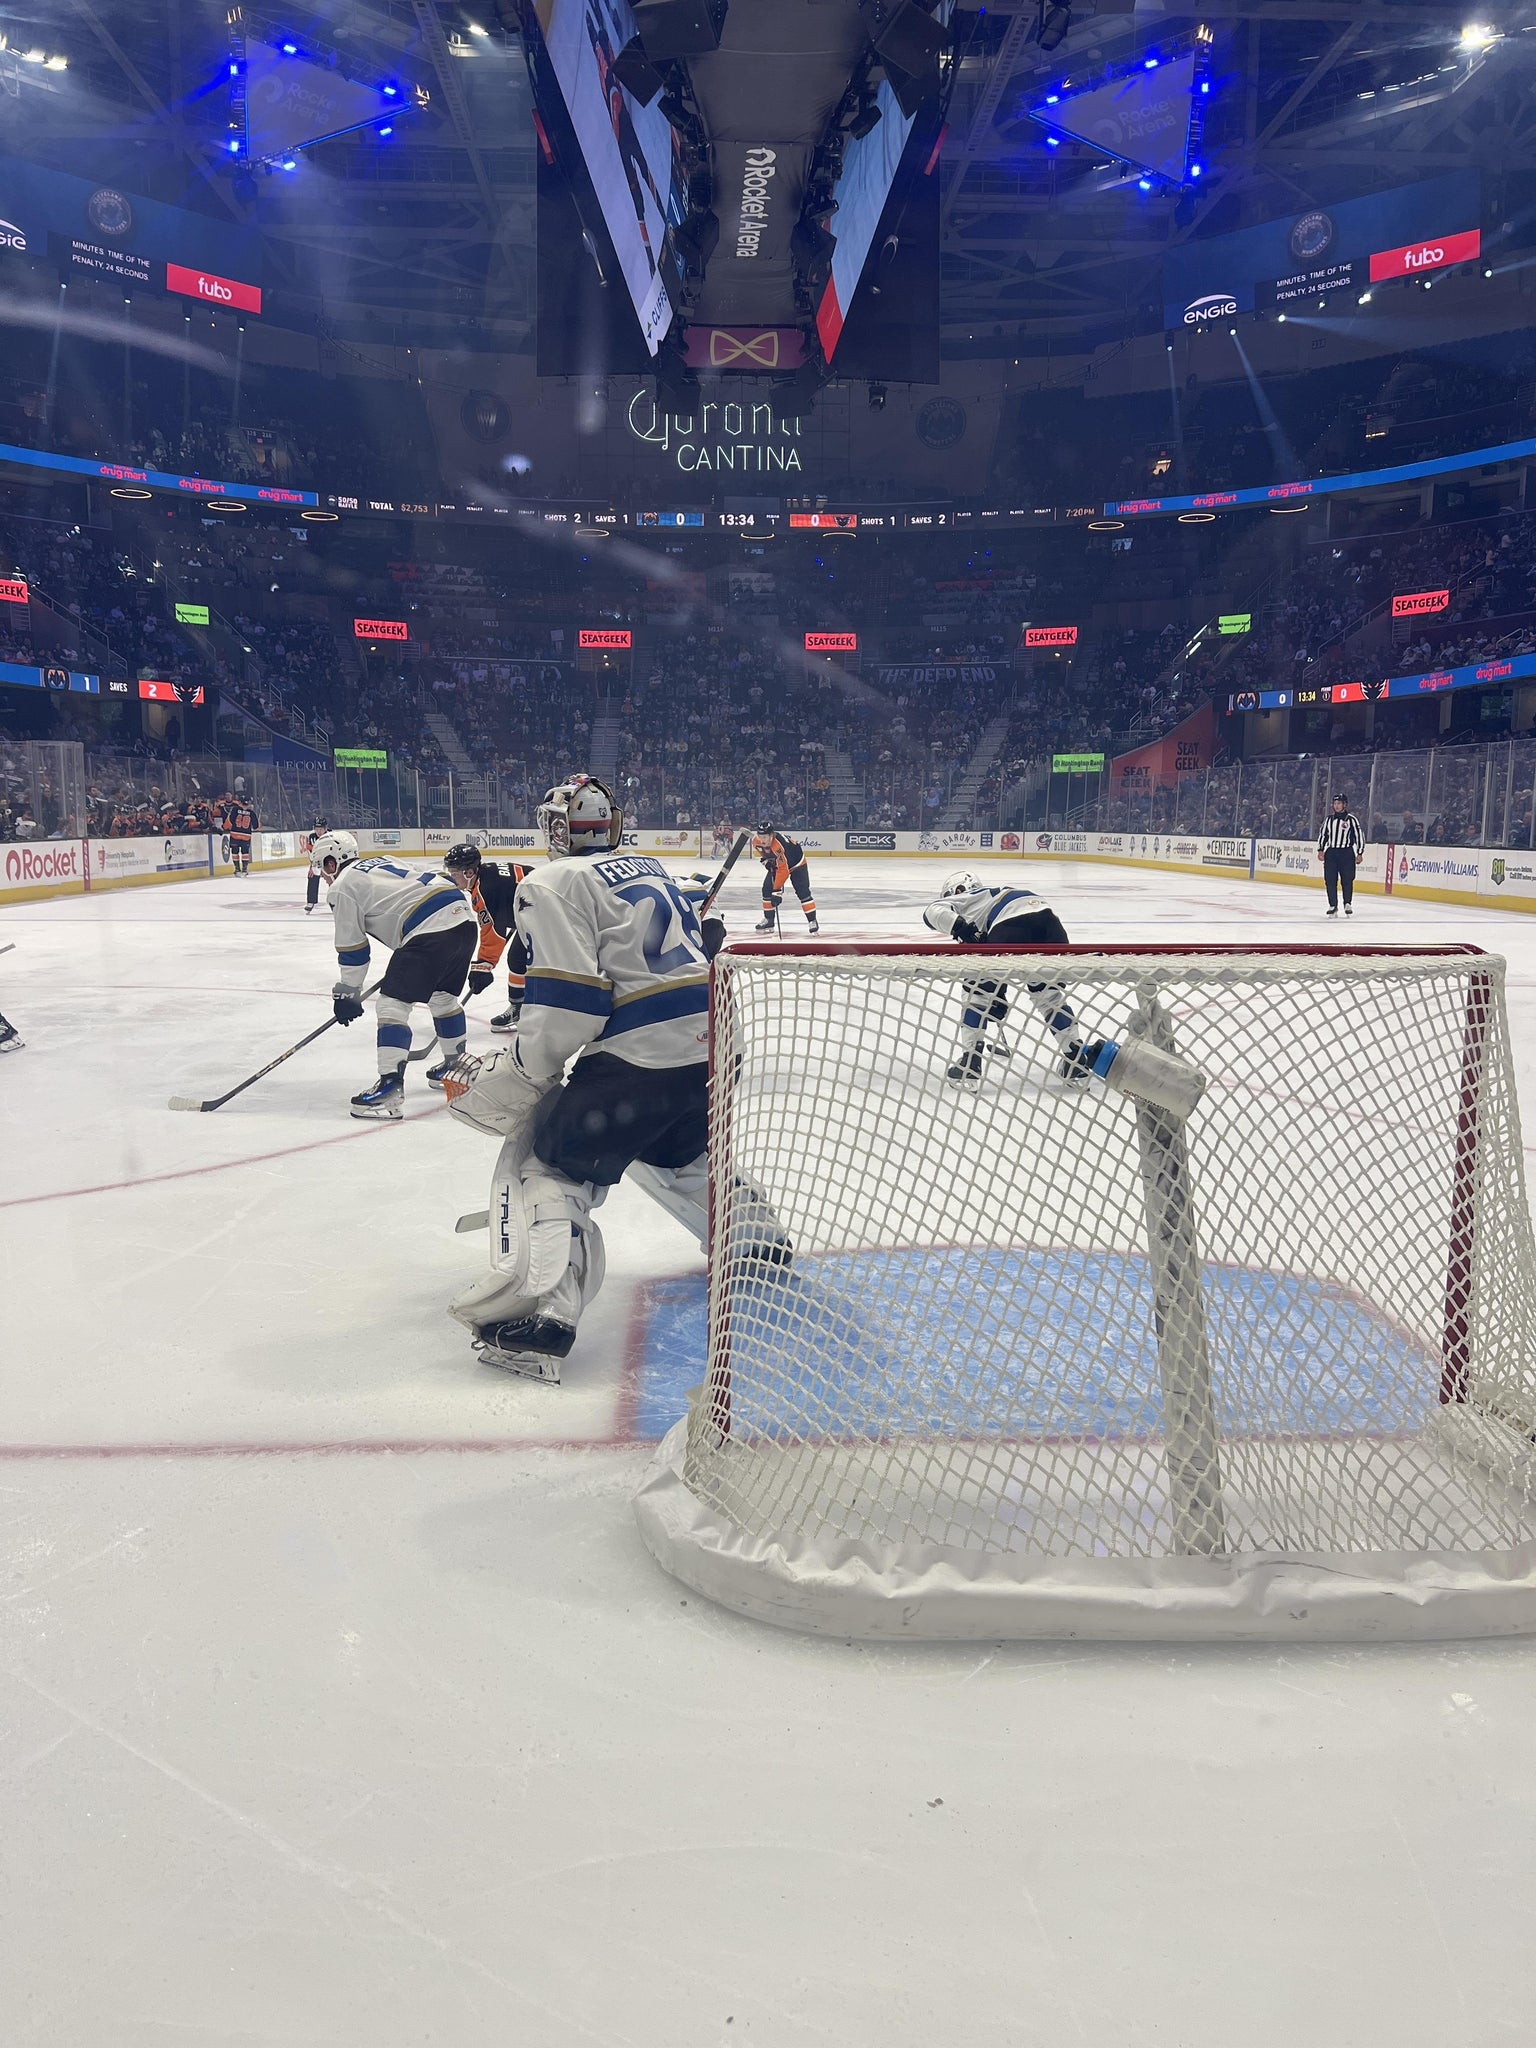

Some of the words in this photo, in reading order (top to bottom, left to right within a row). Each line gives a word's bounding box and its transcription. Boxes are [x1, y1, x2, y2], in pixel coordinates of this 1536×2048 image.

[740, 164, 776, 219] Rocket
[735, 217, 768, 258] Arena
[107, 249, 124, 261] TIME
[125, 254, 136, 264] OF
[137, 257, 151, 268] THE
[1404, 247, 1444, 269] fubo
[105, 262, 115, 272] 24
[1310, 269, 1326, 280] TIME
[1327, 267, 1337, 277] OF
[1339, 263, 1352, 274] THE
[198, 277, 232, 301] fubo
[1308, 286, 1316, 295] 24
[677, 443, 802, 471] CANTINA
[100, 465, 123, 480] drug
[124, 469, 147, 482] mart
[179, 478, 201, 494] drug
[202, 481, 225, 494] mart
[1268, 487, 1289, 498] drug
[1290, 483, 1312, 493] mart
[258, 488, 281, 503] drug
[281, 492, 303, 503] mart
[1192, 496, 1214, 507] drug
[1215, 493, 1237, 503] mart
[369, 501, 394, 511] TOTAL
[400, 503, 428, 514] $2,753
[1117, 503, 1139, 514] drug
[1139, 501, 1161, 511] mart
[544, 513, 567, 522] SHOTS
[574, 513, 582, 524] 2
[595, 514, 616, 523] SAVES
[623, 513, 628, 524] 1
[676, 513, 685, 525] 0
[719, 513, 755, 526] 13:34
[811, 514, 820, 526] 0
[861, 517, 884, 525] SHOTS
[890, 515, 896, 526] 1
[911, 516, 932, 525] SAVES
[938, 514, 946, 525] 2
[1394, 593, 1448, 612] SEATGEEK
[357, 622, 405, 636] SEATGEEK
[581, 633, 629, 645] SEATGEEK
[807, 636, 855, 647] SEATGEEK
[1028, 630, 1075, 643] SEATGEEK
[961, 666, 997, 684] END
[1476, 668, 1493, 681] drug
[1493, 663, 1512, 677] mart
[83, 676, 90, 691] 1
[109, 681, 128, 692] SAVES
[1419, 678, 1436, 691] drug
[1436, 674, 1454, 686] mart
[148, 683, 157, 697] 2
[1298, 691, 1316, 702] 13:34
[1340, 688, 1347, 699] 0
[1279, 693, 1286, 704] 0
[1177, 741, 1200, 756] SEAT
[1175, 757, 1200, 771] GEEK
[1122, 766, 1151, 777] SEAT
[1120, 778, 1151, 788] GEEK
[466, 833, 481, 847] Blue
[488, 833, 535, 849] Technologies
[942, 833, 976, 847] BARONS
[1054, 834, 1087, 842] COLUMBUS
[1054, 842, 1066, 851] BLUE
[1068, 842, 1087, 852] JACKETS
[1211, 840, 1235, 856] CENTER
[1236, 842, 1247, 857] ICE
[22, 845, 77, 880] Rocket
[1493, 859, 1505, 876] 811
[613, 882, 713, 975] 28
[500, 1183, 510, 1254] TRUE
